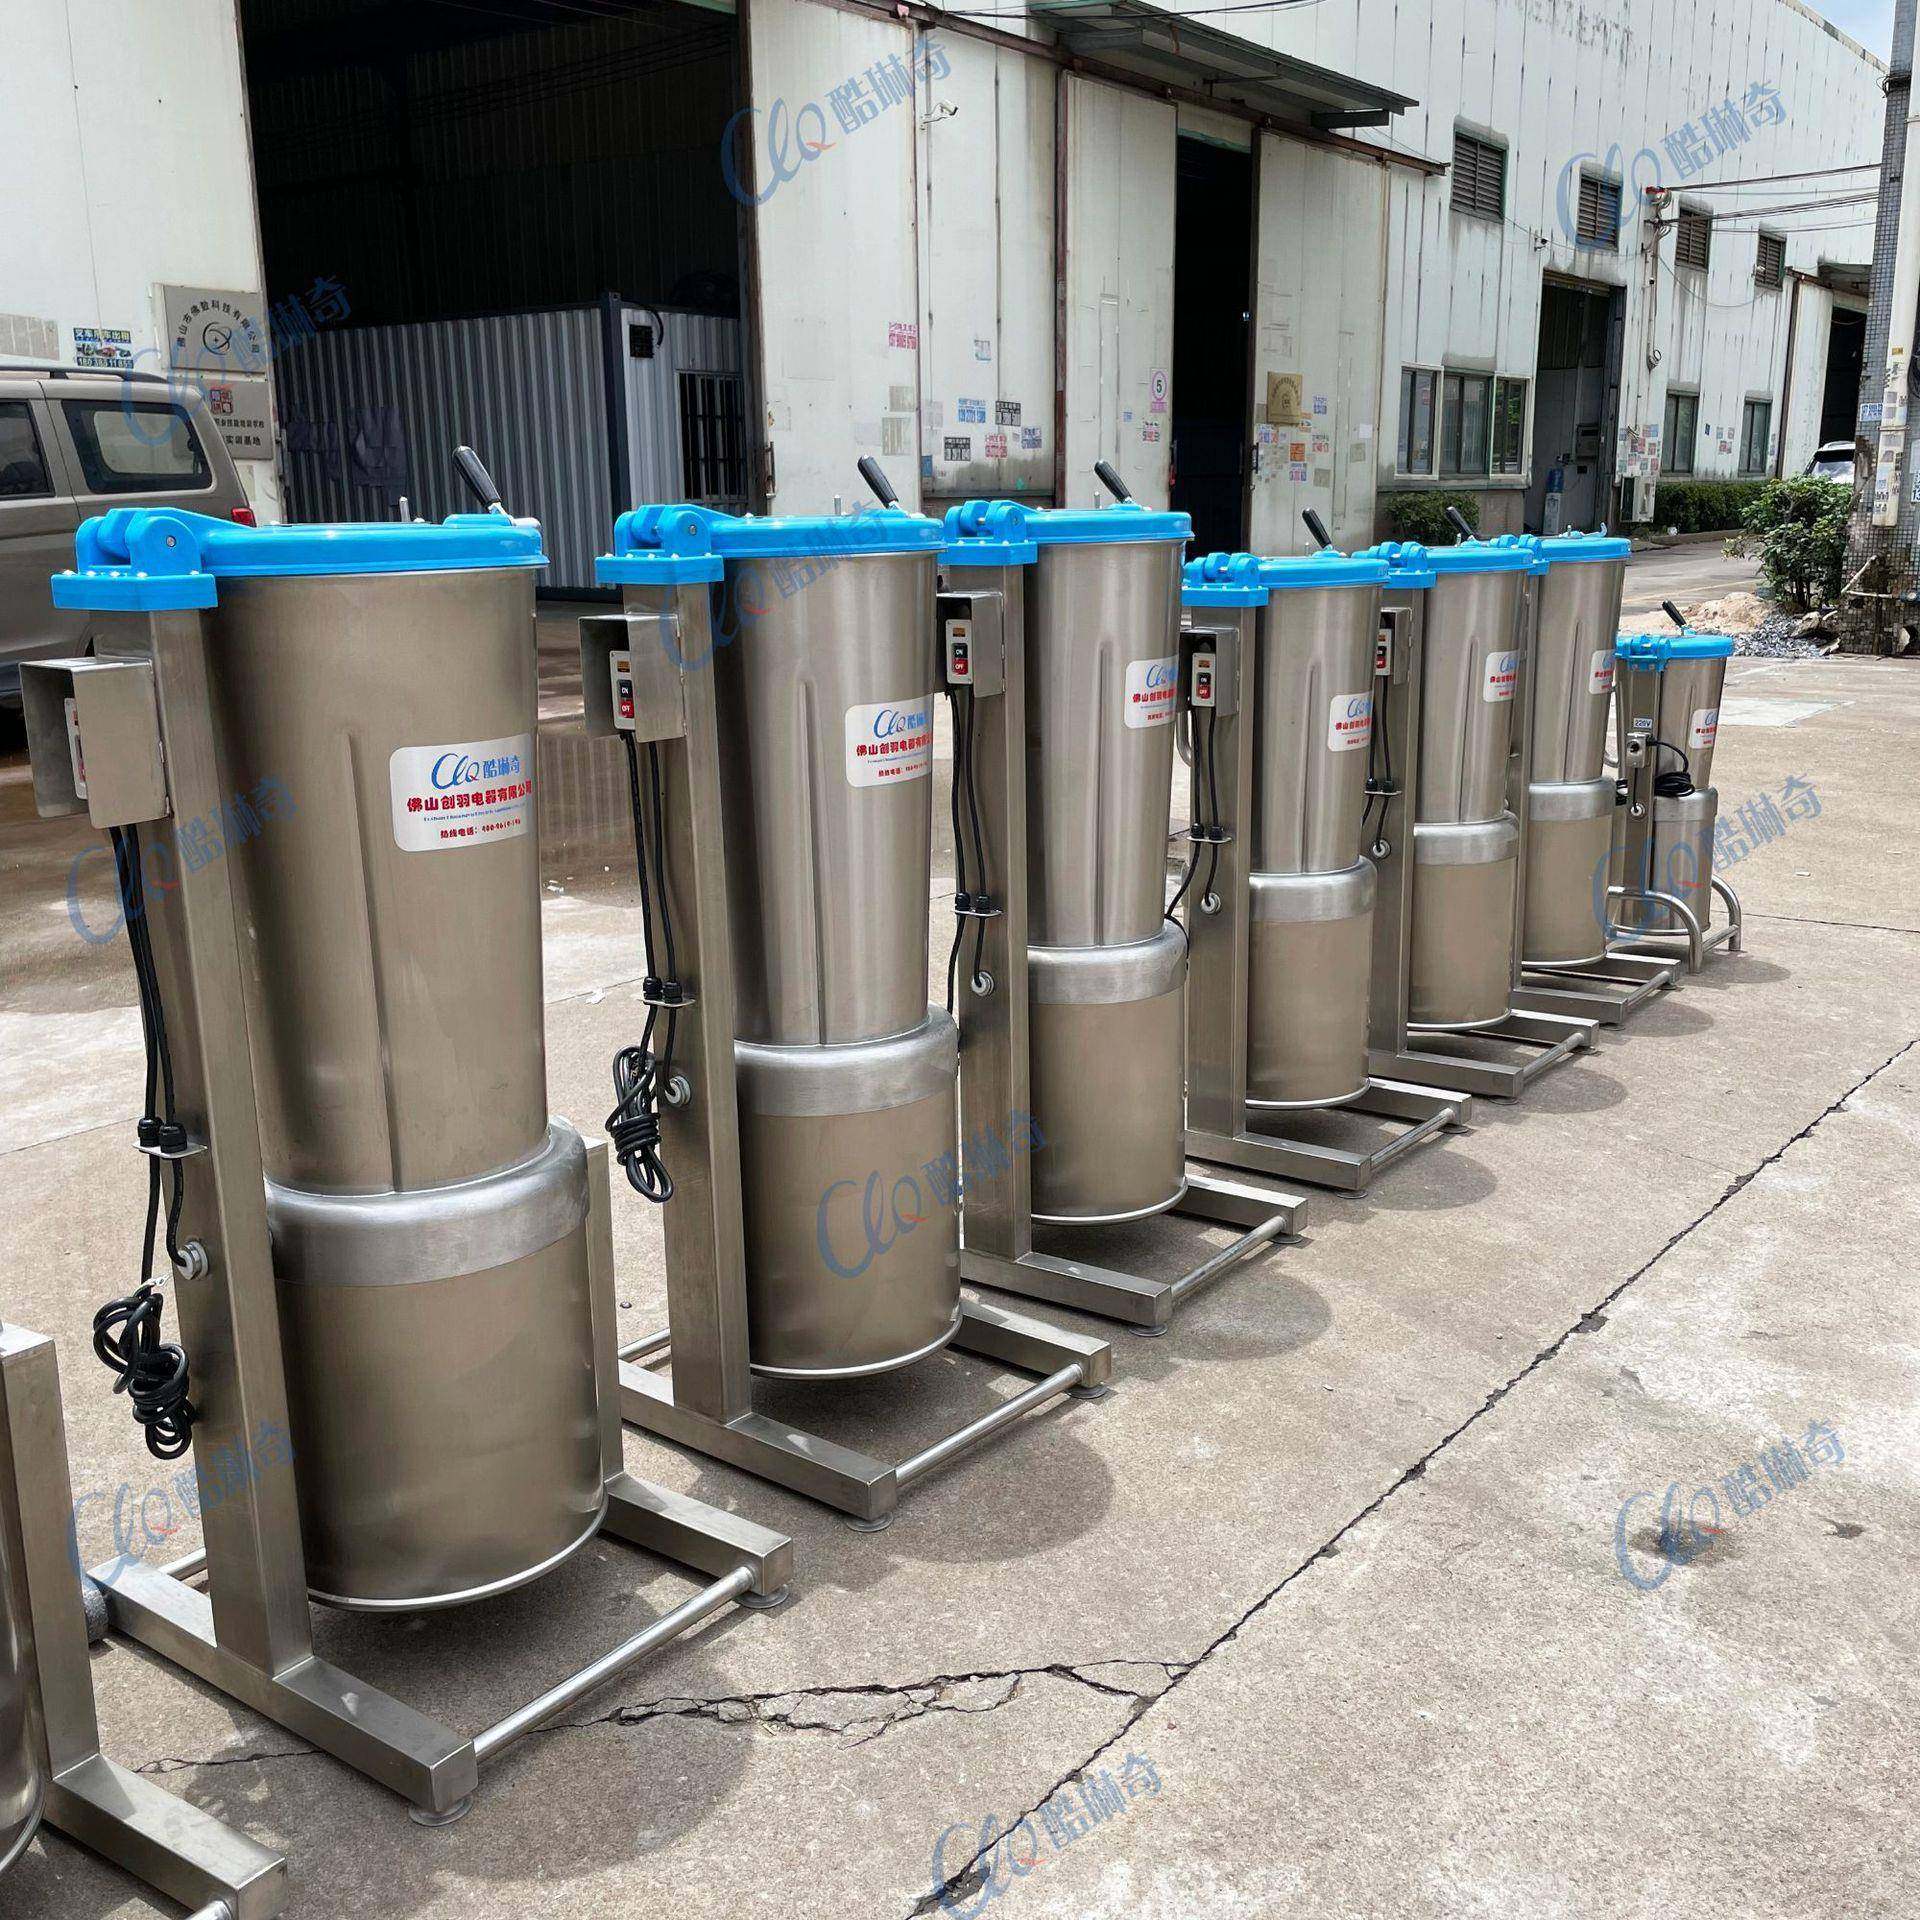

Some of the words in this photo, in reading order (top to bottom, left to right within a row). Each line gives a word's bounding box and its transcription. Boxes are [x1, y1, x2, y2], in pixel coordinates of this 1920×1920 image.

[1156, 379, 1163, 393] 5
[482, 755, 521, 779] 酷琳奇
[407, 780, 533, 813] 佛山创羽电器有限公司
